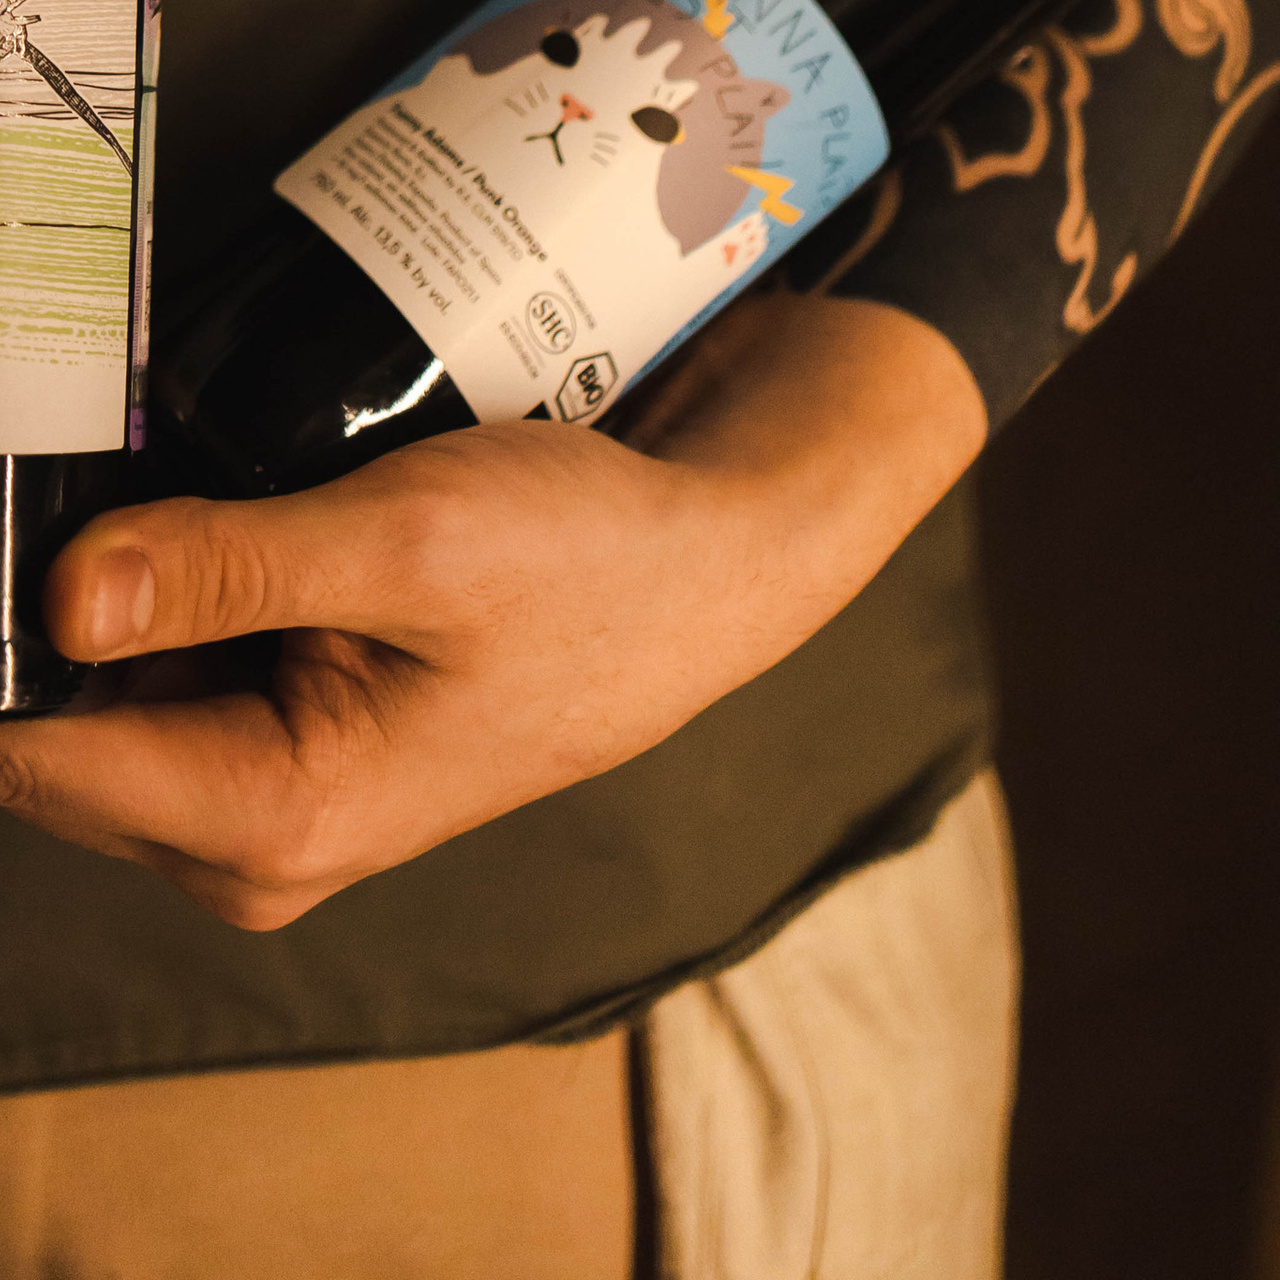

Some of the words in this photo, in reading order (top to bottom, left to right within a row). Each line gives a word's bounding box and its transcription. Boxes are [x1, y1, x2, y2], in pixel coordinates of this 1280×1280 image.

[502, 206, 549, 262] Orange
[410, 267, 430, 290] by
[531, 298, 570, 348] SHC
